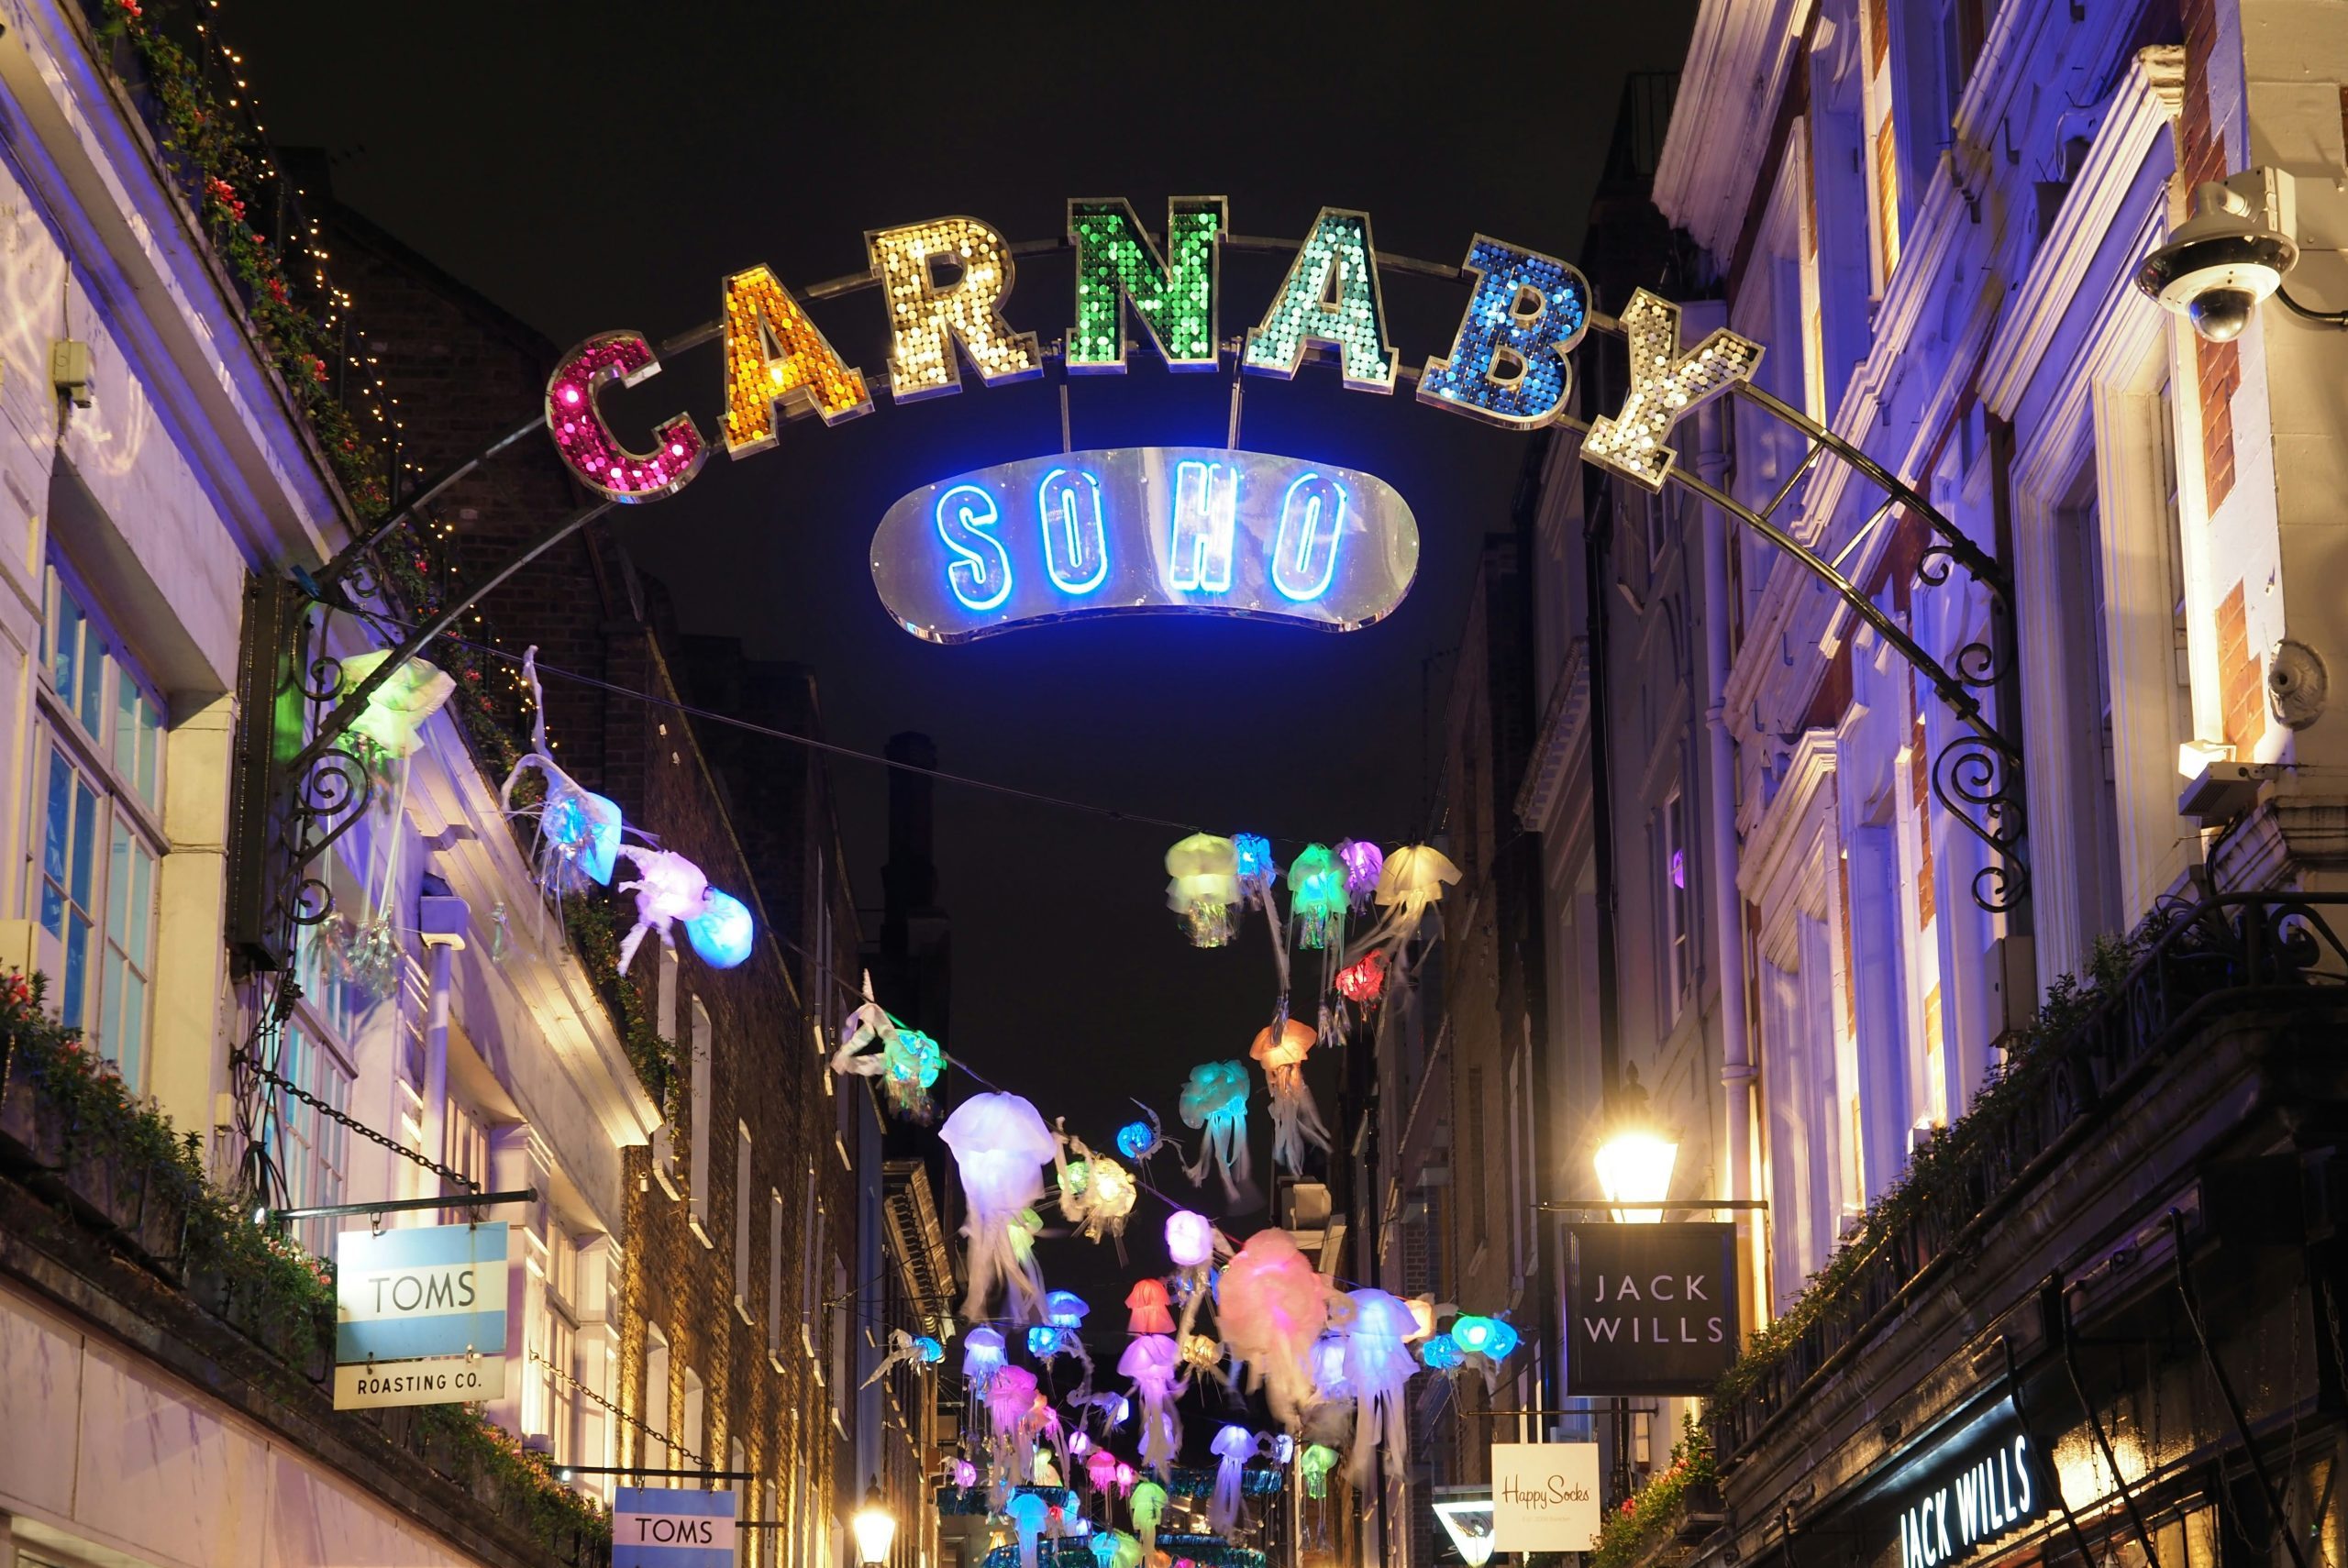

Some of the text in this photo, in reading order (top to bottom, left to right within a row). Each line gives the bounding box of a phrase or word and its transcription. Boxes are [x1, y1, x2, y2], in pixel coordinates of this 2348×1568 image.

[545, 195, 1767, 503] CARNABY
[936, 460, 1348, 611] SOHO
[369, 1270, 475, 1313] TOMS
[1595, 1275, 1709, 1303] JACK
[1584, 1317, 1723, 1343] WILLS
[358, 1373, 482, 1395] ROASTING CO.
[1501, 1474, 1589, 1510] Happy Socks
[1900, 1434, 2031, 1568] JACK WILLS
[635, 1518, 713, 1544] TOMS
